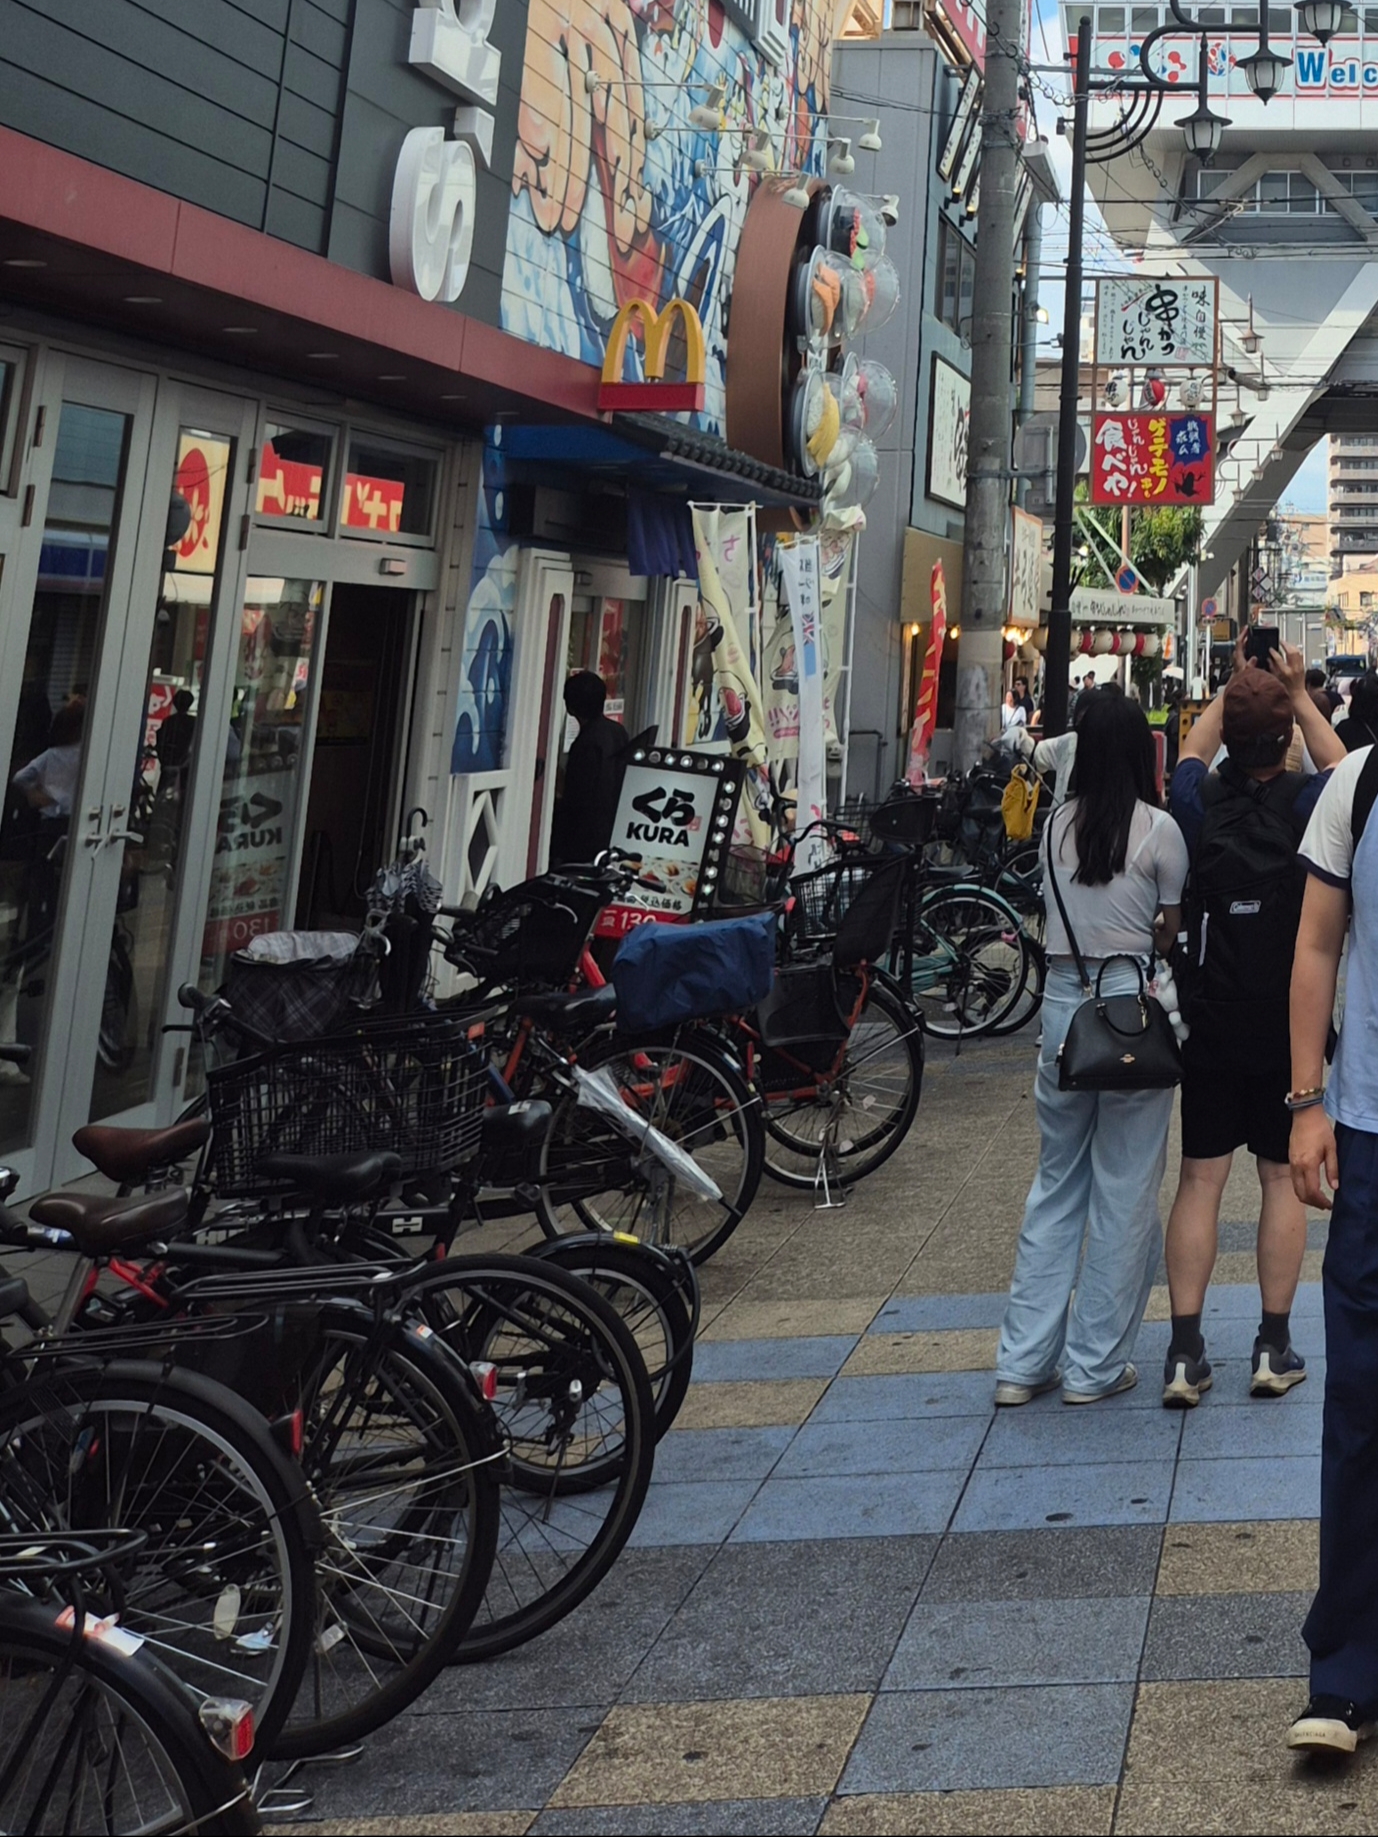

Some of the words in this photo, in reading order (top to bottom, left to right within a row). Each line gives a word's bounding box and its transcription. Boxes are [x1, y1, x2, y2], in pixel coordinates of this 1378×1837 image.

[1145, 283, 1179, 356] 串かつ
[1147, 417, 1169, 495] ゲテモノ
[625, 821, 690, 848] KURA
[631, 785, 696, 827] くら
